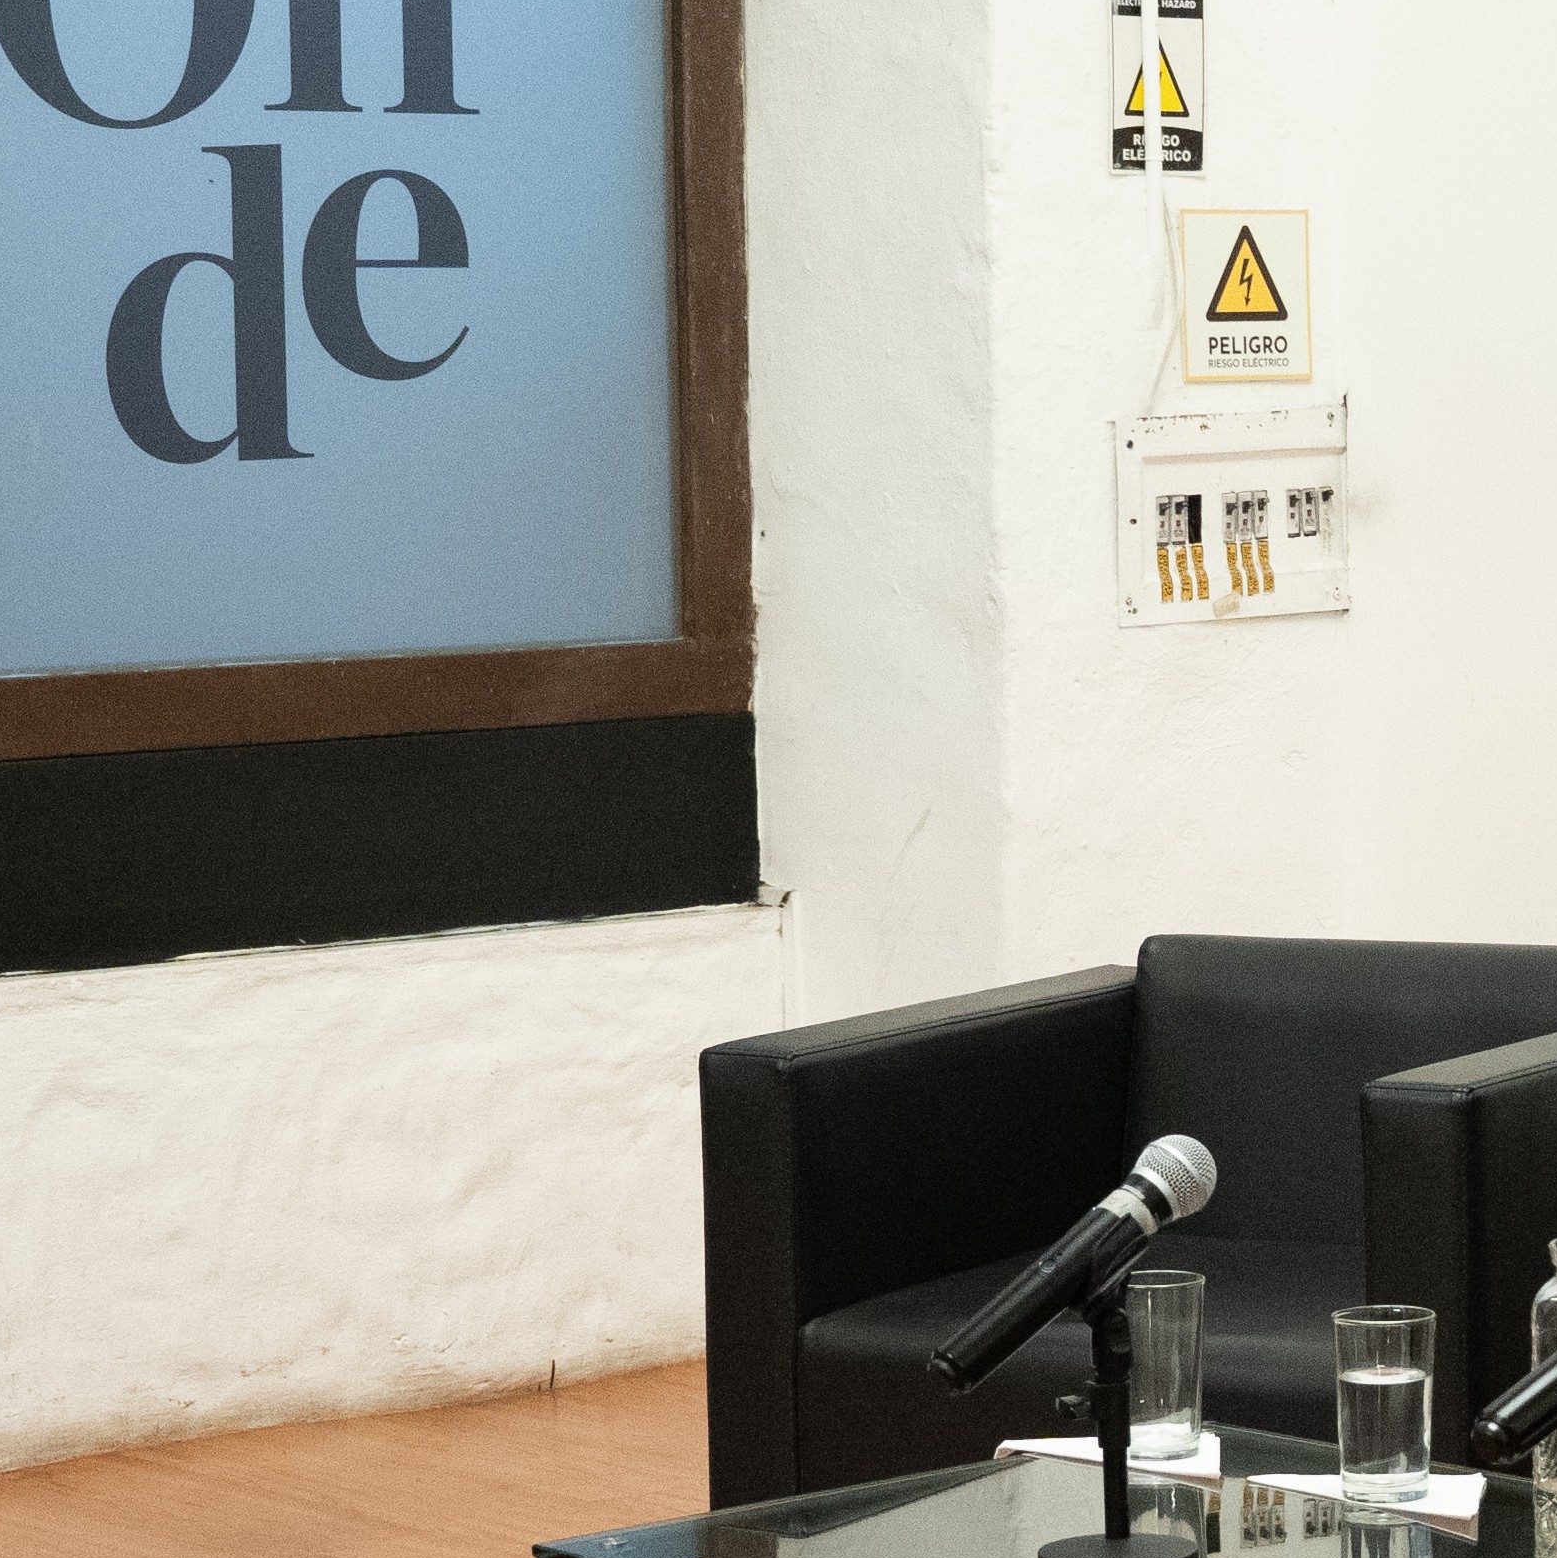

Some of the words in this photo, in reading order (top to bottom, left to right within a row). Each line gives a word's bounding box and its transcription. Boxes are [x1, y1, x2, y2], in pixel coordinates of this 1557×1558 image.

[1161, 0, 1196, 9] HAZARD
[1133, 134, 1180, 147] RIGO
[1123, 146, 1191, 162] ELÉRICO
[107, 144, 470, 464] de
[1208, 336, 1288, 354] PELIGRO
[1208, 358, 1239, 368] RIESGO
[1243, 357, 1289, 368] ELÉCTRICO
